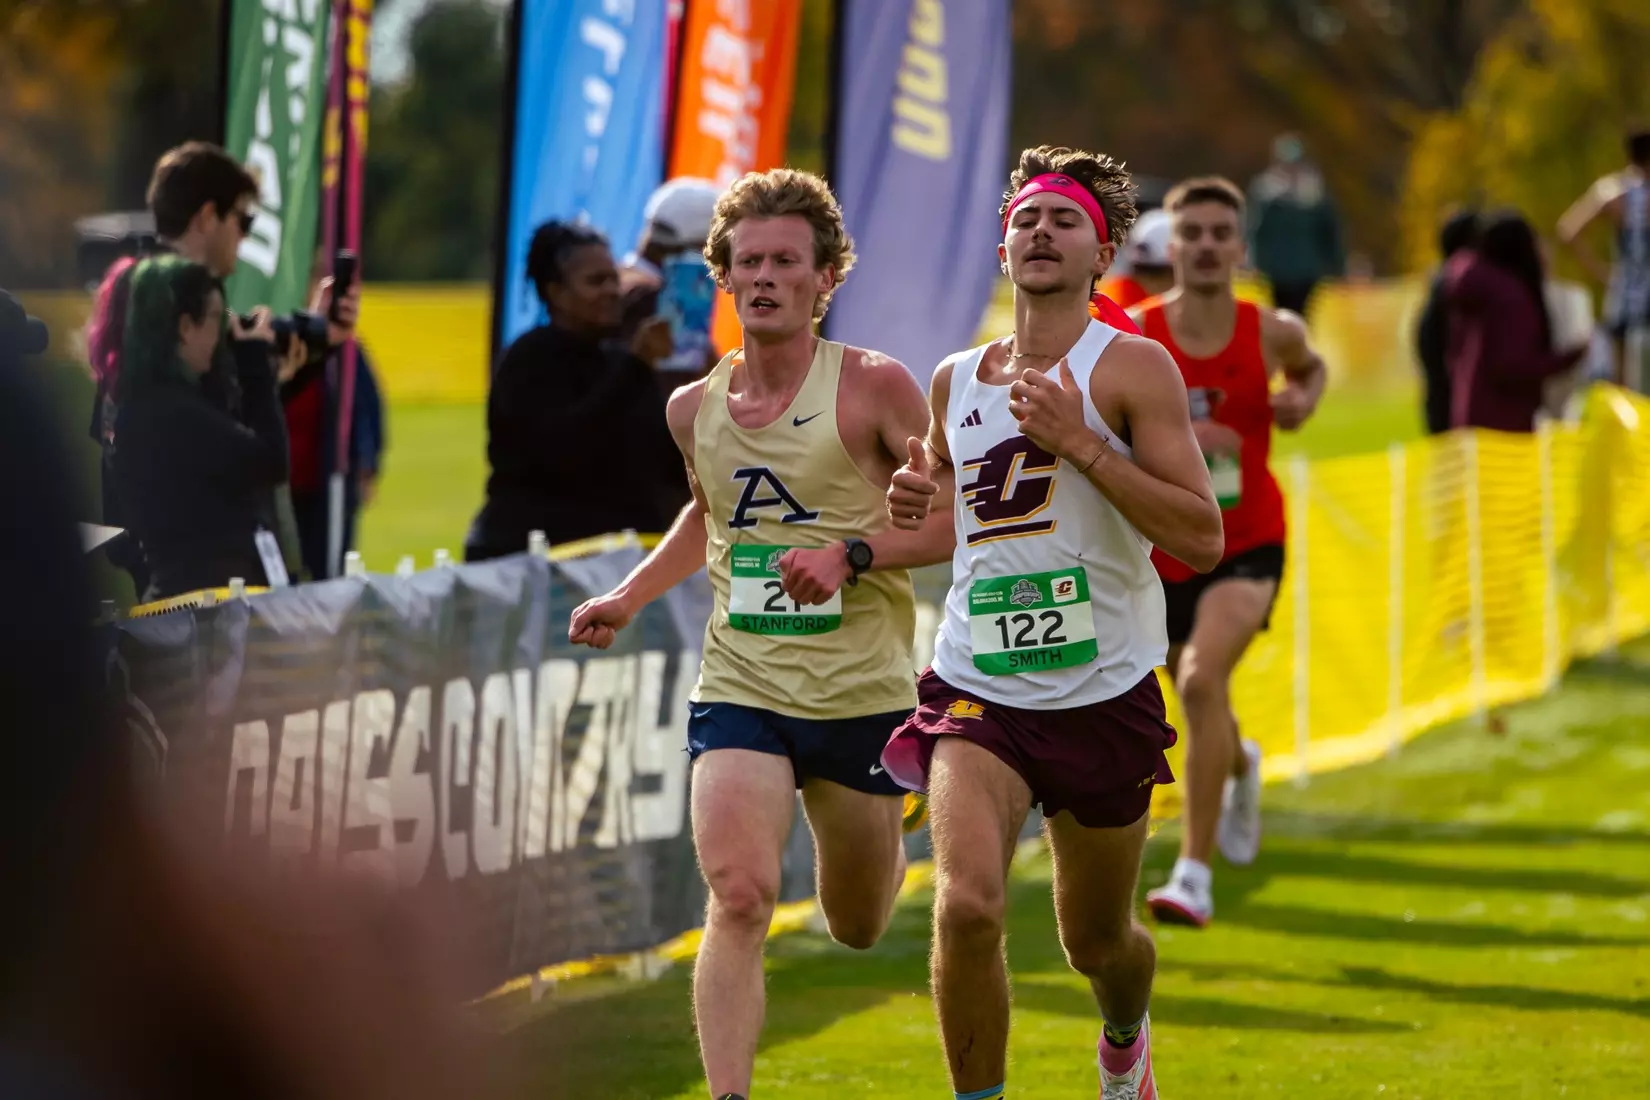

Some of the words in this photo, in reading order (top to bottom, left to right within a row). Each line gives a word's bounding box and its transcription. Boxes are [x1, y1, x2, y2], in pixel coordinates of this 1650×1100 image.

[728, 465, 820, 529] A
[962, 435, 1060, 540] C
[741, 614, 828, 632] STANFORD
[995, 610, 1067, 650] 122
[1008, 650, 1062, 668] SMITH
